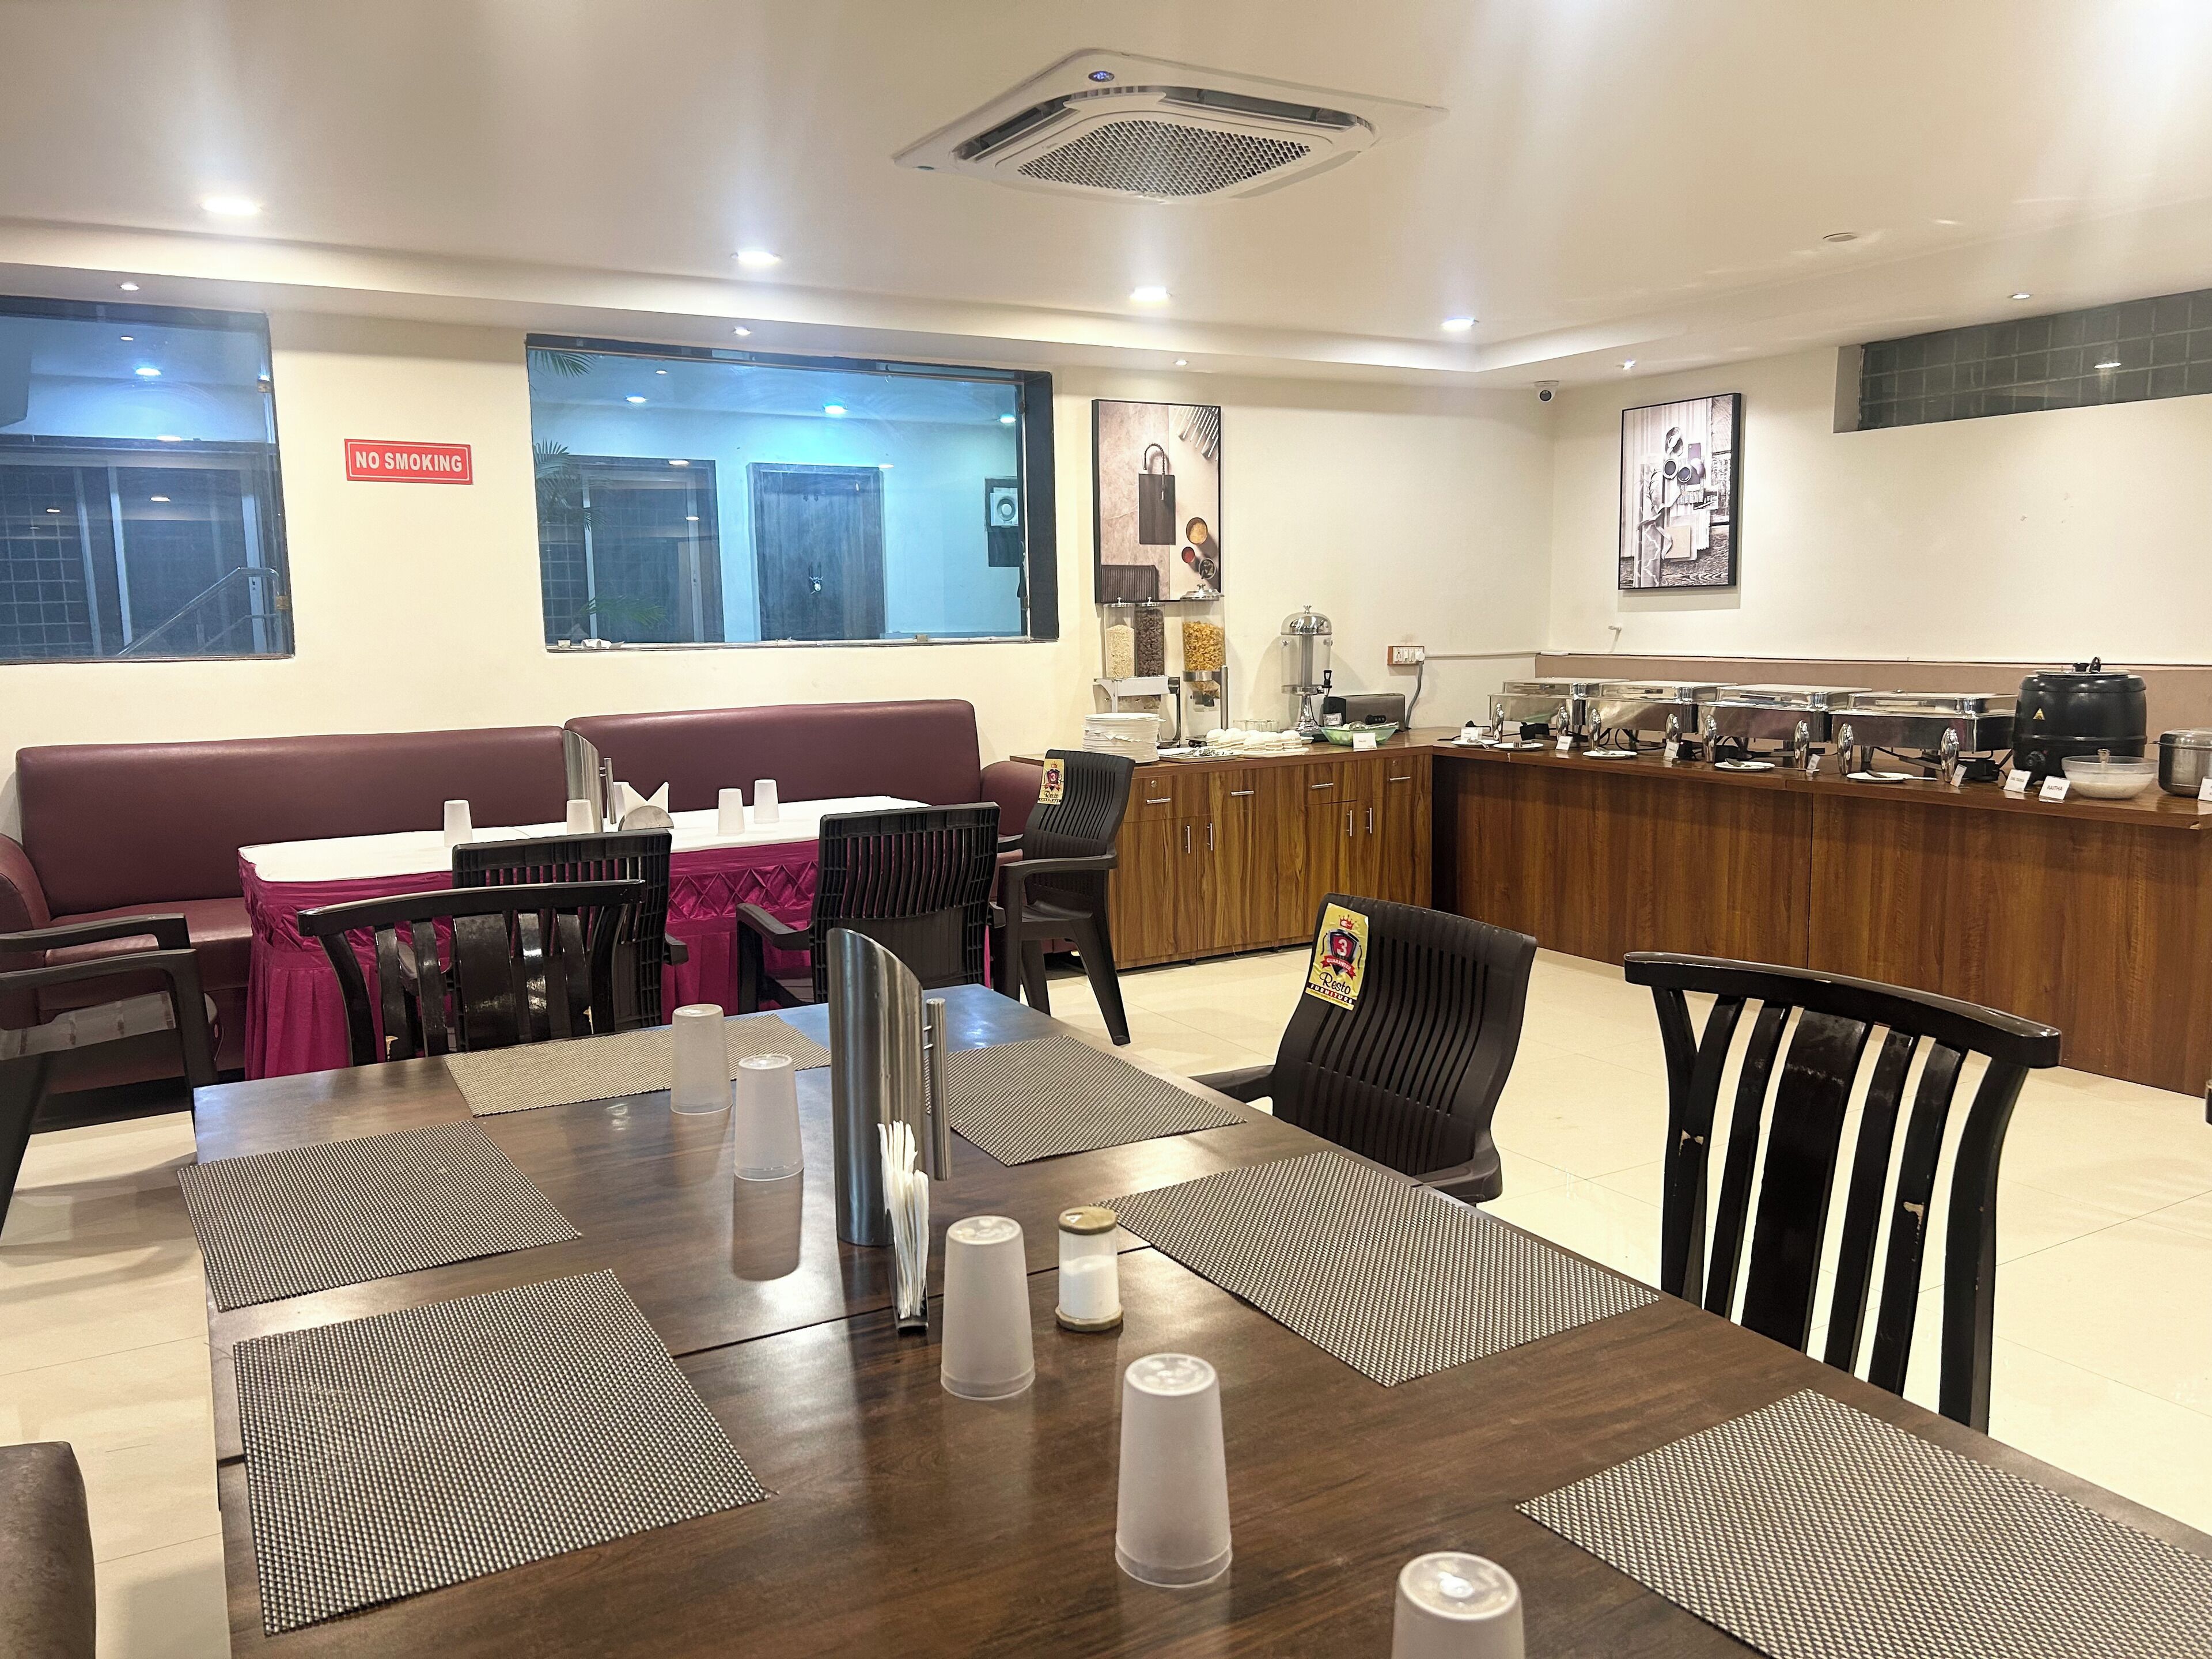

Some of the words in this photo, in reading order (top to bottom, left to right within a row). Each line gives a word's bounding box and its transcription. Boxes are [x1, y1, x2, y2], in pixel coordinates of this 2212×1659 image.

[355, 451, 380, 469] NO
[384, 452, 462, 472] SMOKING
[1336, 938, 1348, 956] 3
[1326, 958, 1351, 971] GUARANTEE
[1319, 972, 1351, 995] Resto
[1310, 984, 1353, 1004] FURNITURE
